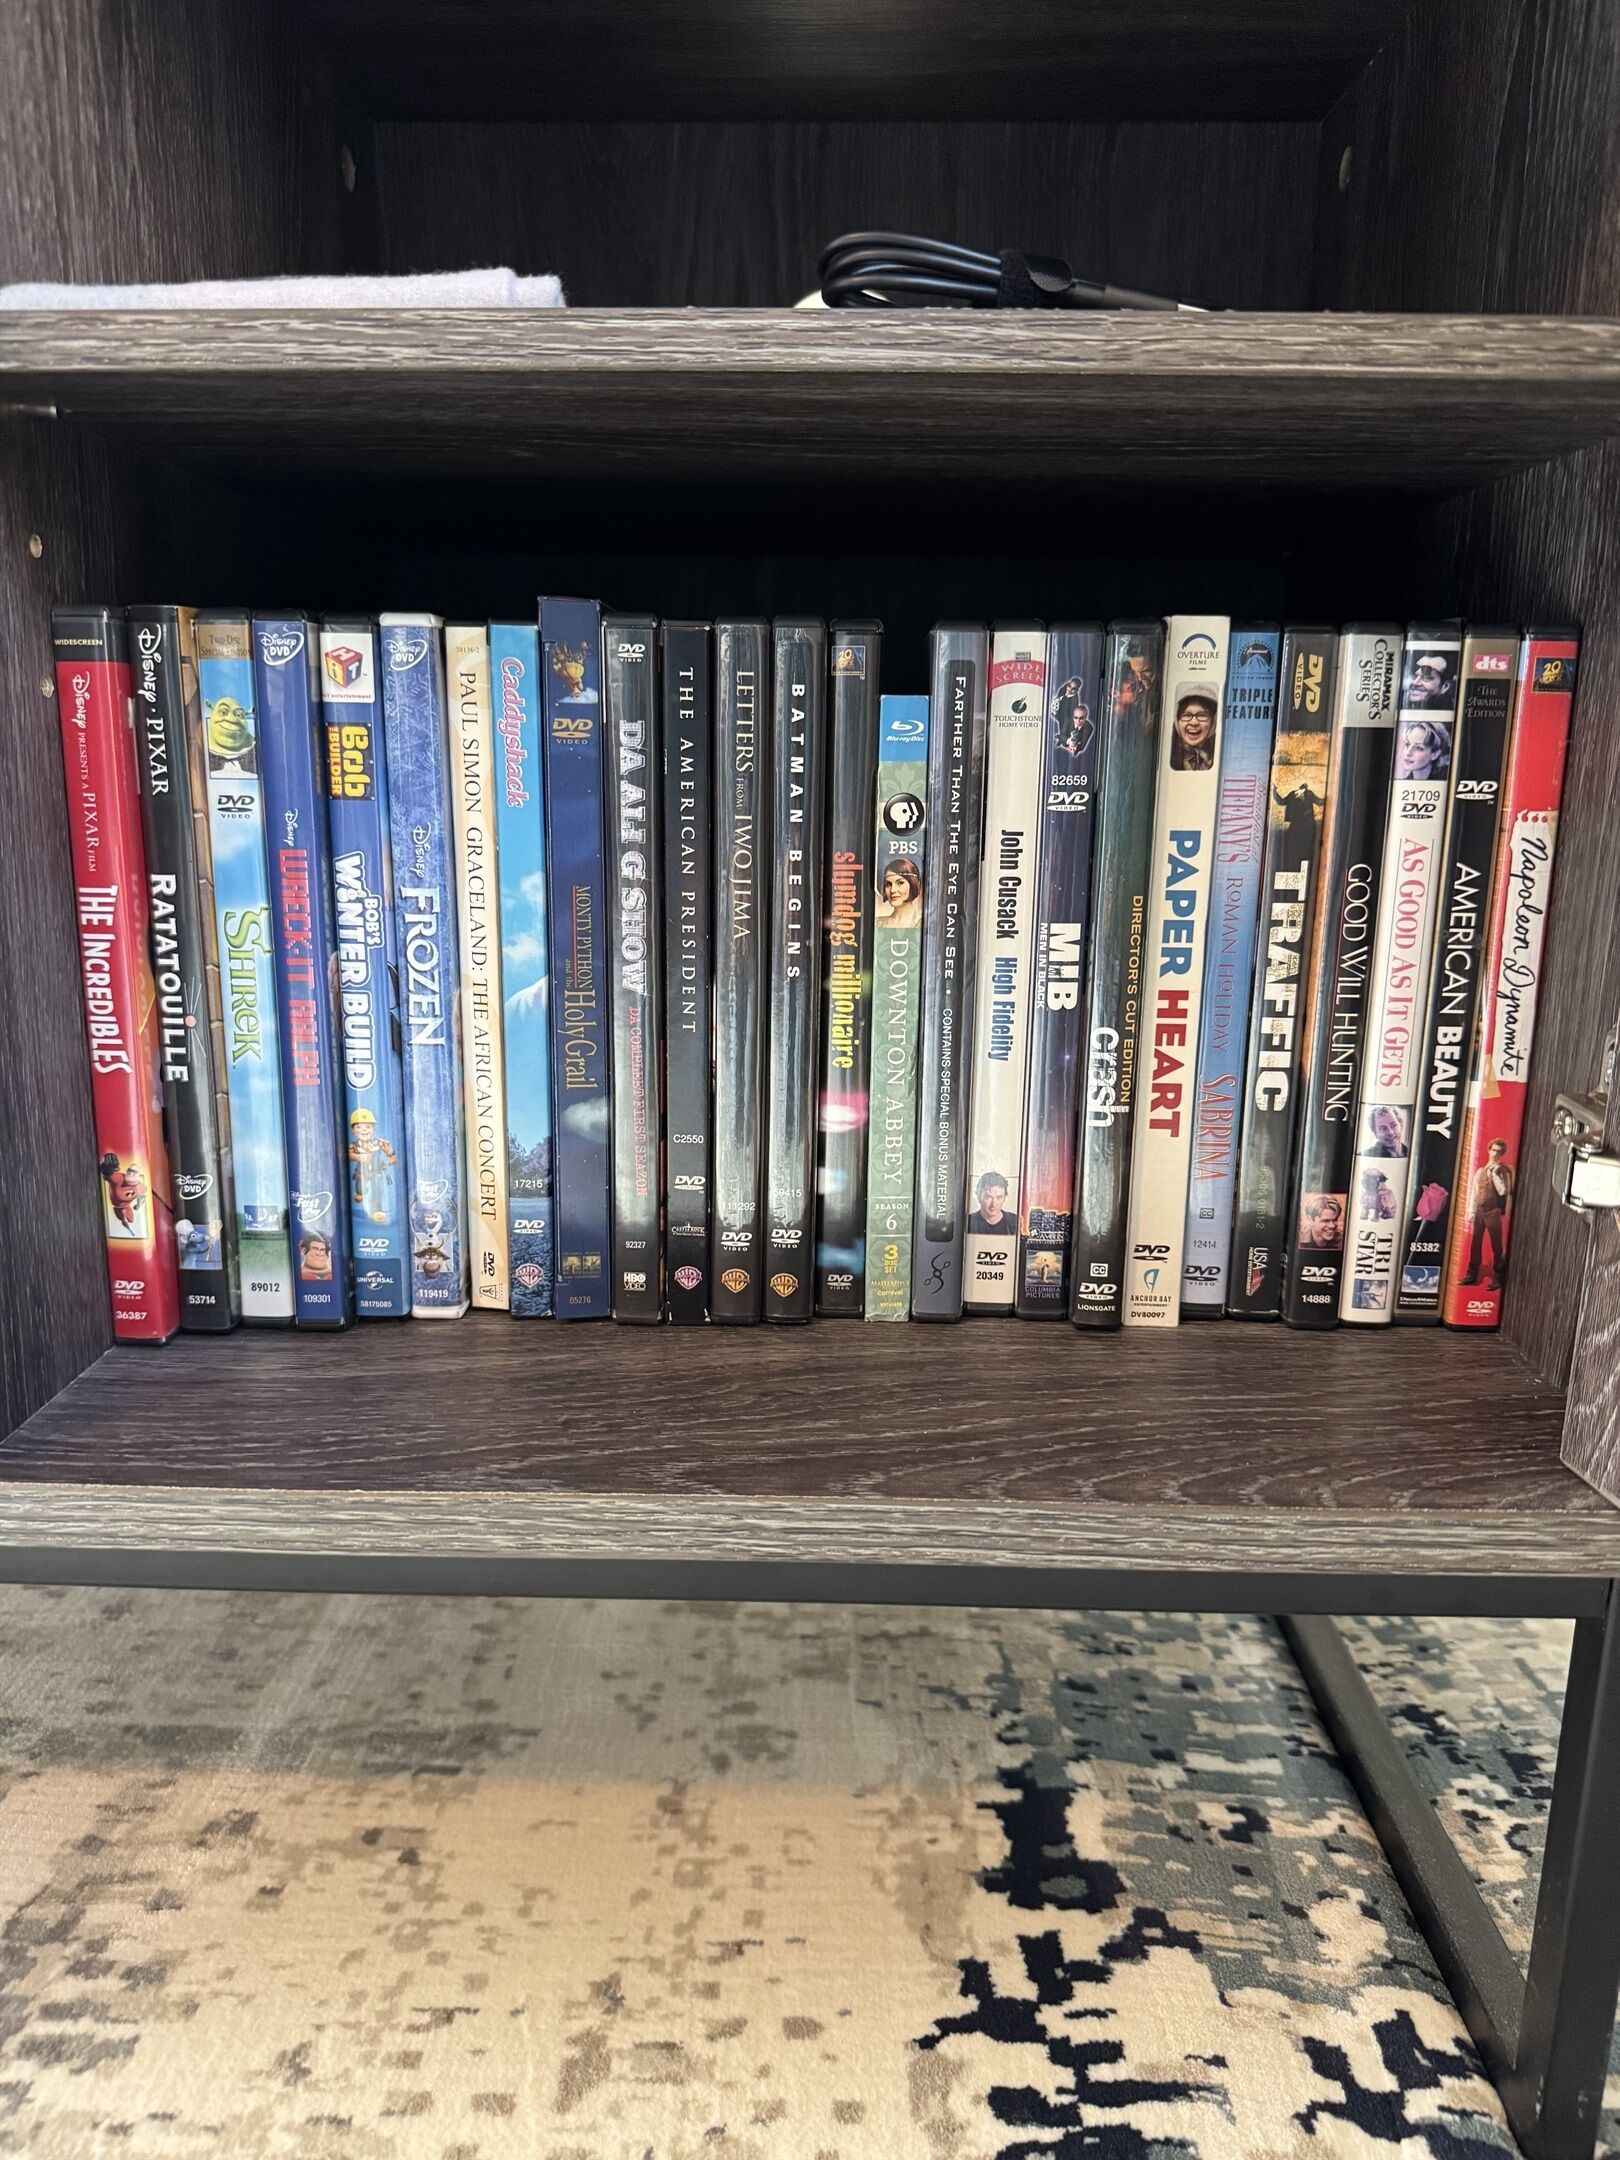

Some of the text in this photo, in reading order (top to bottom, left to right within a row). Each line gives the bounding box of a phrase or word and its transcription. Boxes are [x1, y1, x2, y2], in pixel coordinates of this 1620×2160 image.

[619, 644, 645, 652] DVD
[1001, 663, 1041, 673] WIDE
[1178, 651, 1219, 659] OVERTURE
[1475, 656, 1509, 671] dts
[996, 672, 1043, 682] SCREEN
[1231, 687, 1274, 704] TRIPLE
[1356, 660, 1372, 702] SERIES
[1368, 638, 1387, 720] COLLECTOR'S
[1381, 651, 1395, 712] MIRAMAX
[78, 732, 89, 780] PRESENTS
[147, 717, 169, 796] PIXAR
[497, 657, 530, 808] Caddyshack
[620, 720, 646, 775] DA
[329, 733, 342, 796] BUILDER
[1051, 775, 1087, 786] 82659
[83, 792, 100, 848] PIXAR
[729, 671, 754, 940] LETTERS FROM IWO JIMA
[1402, 790, 1440, 801] 21709
[1402, 803, 1436, 814] DVD
[679, 667, 695, 1032] THE AMERICAN PRESIDENT
[786, 684, 805, 978] BATMAN BEGINS
[889, 841, 917, 854] PBS
[87, 850, 97, 873] FILM
[621, 851, 646, 880] G
[996, 830, 1023, 940] John Cusack
[364, 896, 383, 947] BOB'S
[1159, 830, 1202, 978] PAPER
[460, 672, 497, 1220] PAUL SIMON GRACELAND: THE AFRICAN CONCERT
[576, 886, 592, 989] MONTY PYTHON
[621, 888, 647, 996] SHOW
[830, 851, 863, 1069] slumdog millionaire
[936, 676, 966, 1219] FARTHER THAN THE EYE CAN SEE CONTAINS SPECIAL BONUS MATERIAL
[1380, 838, 1429, 1087] AS GOOD AS IT GETS
[1496, 836, 1548, 1075] Napoleon Dynamite
[79, 885, 133, 1074] THE INCREDIBLES
[151, 874, 189, 1082] RATATOUILLE
[400, 886, 445, 1046] FROZEN
[1036, 923, 1048, 1009] MEN IN BLACK
[1046, 923, 1081, 1011] MIB
[1212, 877, 1243, 1054] ROMAN HOLIDAY
[1255, 860, 1309, 1112] TRAFFIC
[630, 1006, 641, 1024] DA
[988, 957, 1017, 1061] High Fidelity
[1120, 896, 1143, 1103] DIRECTOR'S CUT EDITION
[1325, 863, 1372, 1122] GOOD WILL HUNTING
[1426, 862, 1482, 1140] AMERICAN BEAUTY
[288, 1001, 320, 1086] RALPH
[343, 991, 374, 1088] BUILD
[558, 990, 598, 1090] Holy Grail
[884, 938, 909, 1185] DOWNTON ABBEY
[1149, 989, 1190, 1138] HEART
[633, 1100, 646, 1141] FIRST
[673, 1135, 704, 1144] C2550
[1192, 1074, 1236, 1182] SABRINA
[635, 1145, 648, 1196] SEAZON
[626, 1241, 645, 1249] 92327
[886, 1213, 897, 1230] 6
[1193, 1240, 1216, 1249] 12414
[884, 1244, 898, 1260] 3
[977, 1252, 1007, 1260] DVD
[1253, 1247, 1268, 1270] USA
[1301, 1266, 1337, 1277] DVD
[1355, 1230, 1377, 1275] STAR
[1374, 1232, 1393, 1274] TRI
[1410, 1242, 1440, 1253] 85382
[189, 1296, 216, 1304] 53714
[251, 1283, 280, 1292] 89012
[419, 1289, 448, 1298] 119419
[624, 1272, 645, 1282] HBO
[624, 1282, 645, 1290] VIDEO
[976, 1271, 1004, 1281] 20349
[1130, 1294, 1172, 1303] ANCHOR BAY
[1302, 1295, 1330, 1303] 14888
[116, 1311, 146, 1320] 36387
